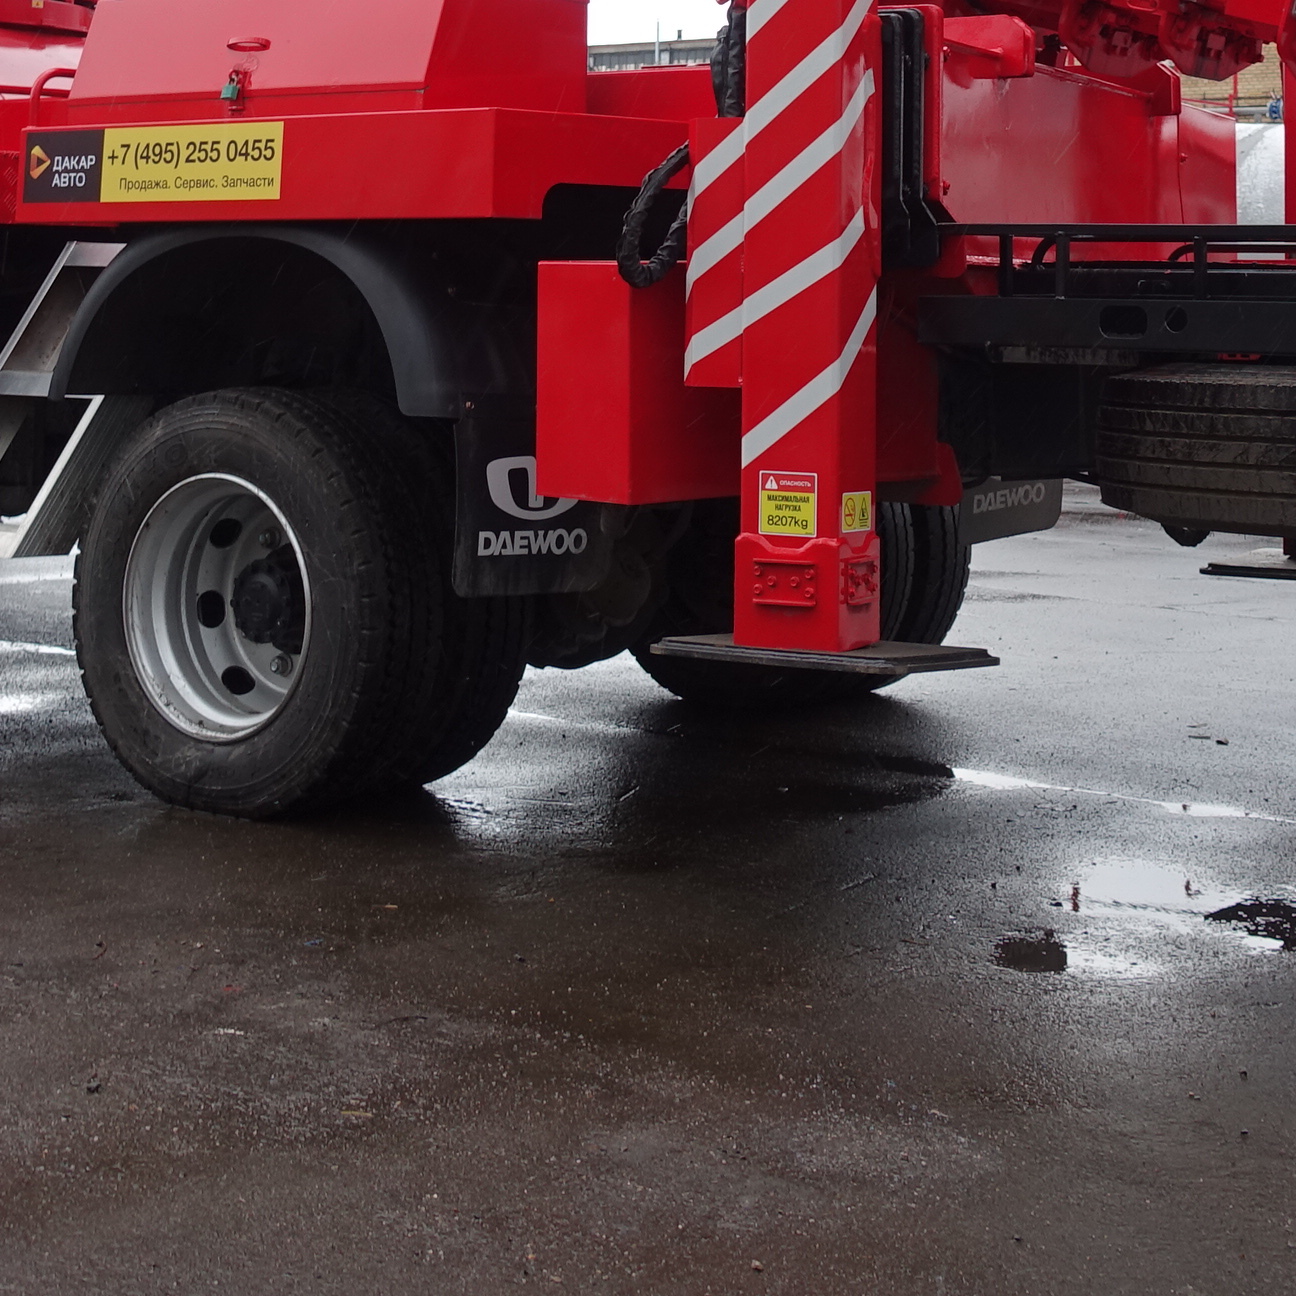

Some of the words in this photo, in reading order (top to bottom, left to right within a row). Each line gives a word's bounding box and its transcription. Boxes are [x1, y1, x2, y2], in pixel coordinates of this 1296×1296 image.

[107, 144, 131, 166] +7
[134, 142, 181, 170] (495)
[185, 140, 221, 164] 255
[226, 139, 275, 163] 0455
[52, 155, 96, 172] ДАКАР
[51, 172, 86, 188] АВТО
[119, 177, 171, 193] Продажа.
[174, 176, 218, 191] Сервис.
[221, 175, 275, 189] Запчасти
[779, 480, 812, 488] ОПАСНОСТЬ
[767, 494, 810, 503] МАКСИМАЛЬНАЯ
[973, 482, 1045, 514] DAEWOO
[775, 504, 802, 512] НАГРУЗКА
[767, 514, 808, 530] 8207kg
[477, 528, 588, 556] DAEWOO
